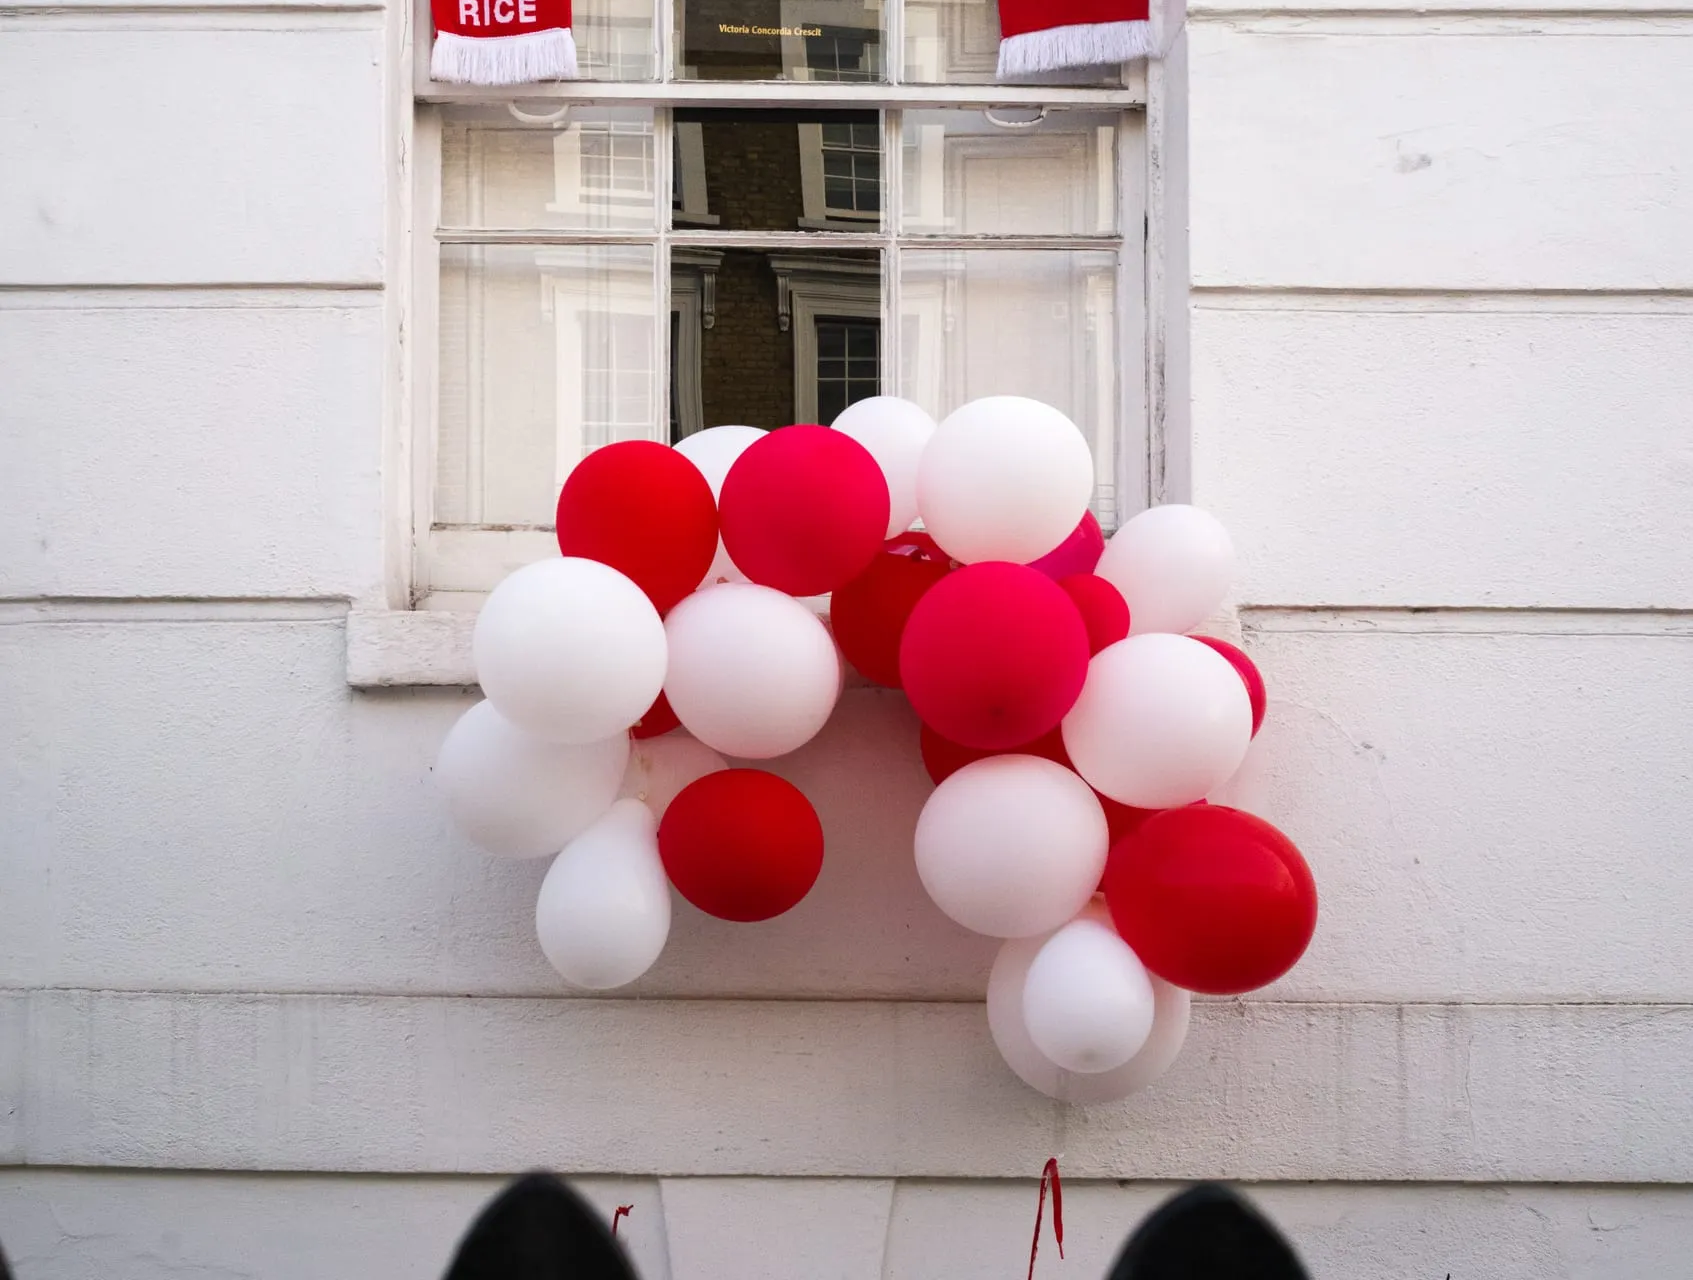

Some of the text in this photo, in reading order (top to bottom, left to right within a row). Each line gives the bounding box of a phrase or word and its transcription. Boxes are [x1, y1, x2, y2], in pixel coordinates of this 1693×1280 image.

[719, 24, 822, 36] Victoria Concordia Crescit
